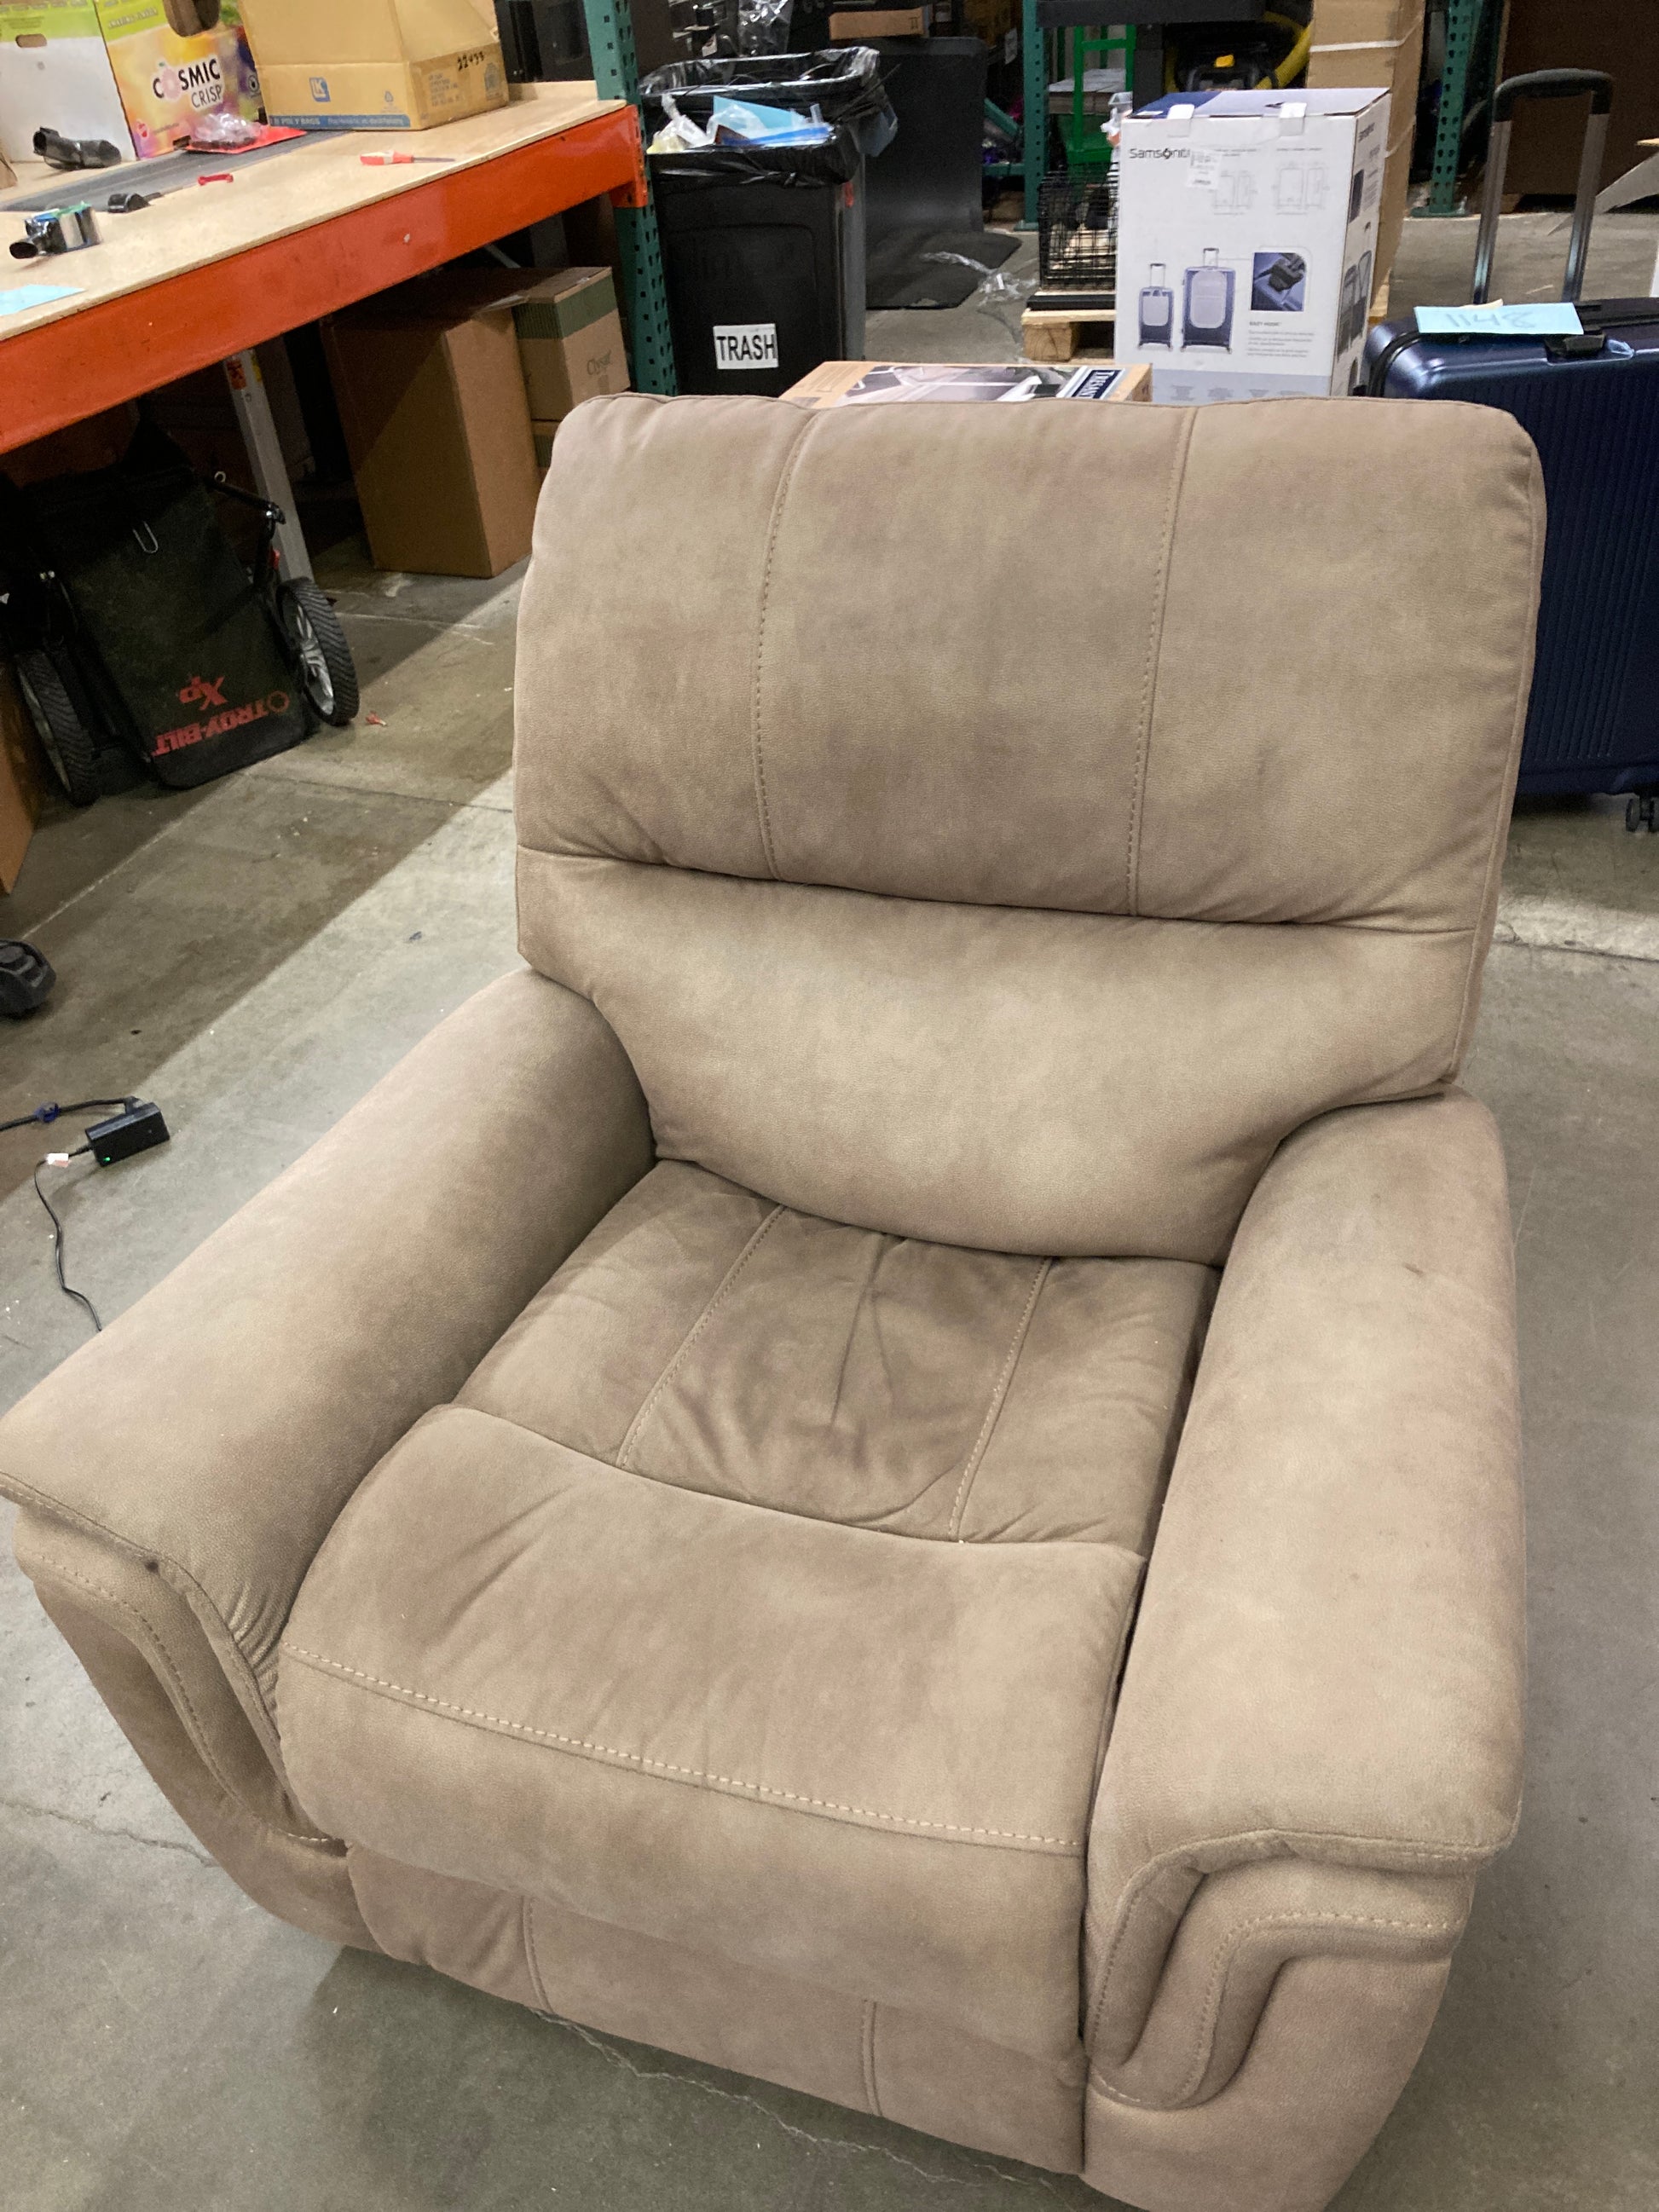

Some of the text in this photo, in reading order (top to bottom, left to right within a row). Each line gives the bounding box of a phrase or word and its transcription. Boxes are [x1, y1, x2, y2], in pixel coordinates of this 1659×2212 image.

[191, 84, 223, 108] CRISP
[716, 334, 778, 361] TRASH
[151, 700, 269, 757] TROY-BILT
